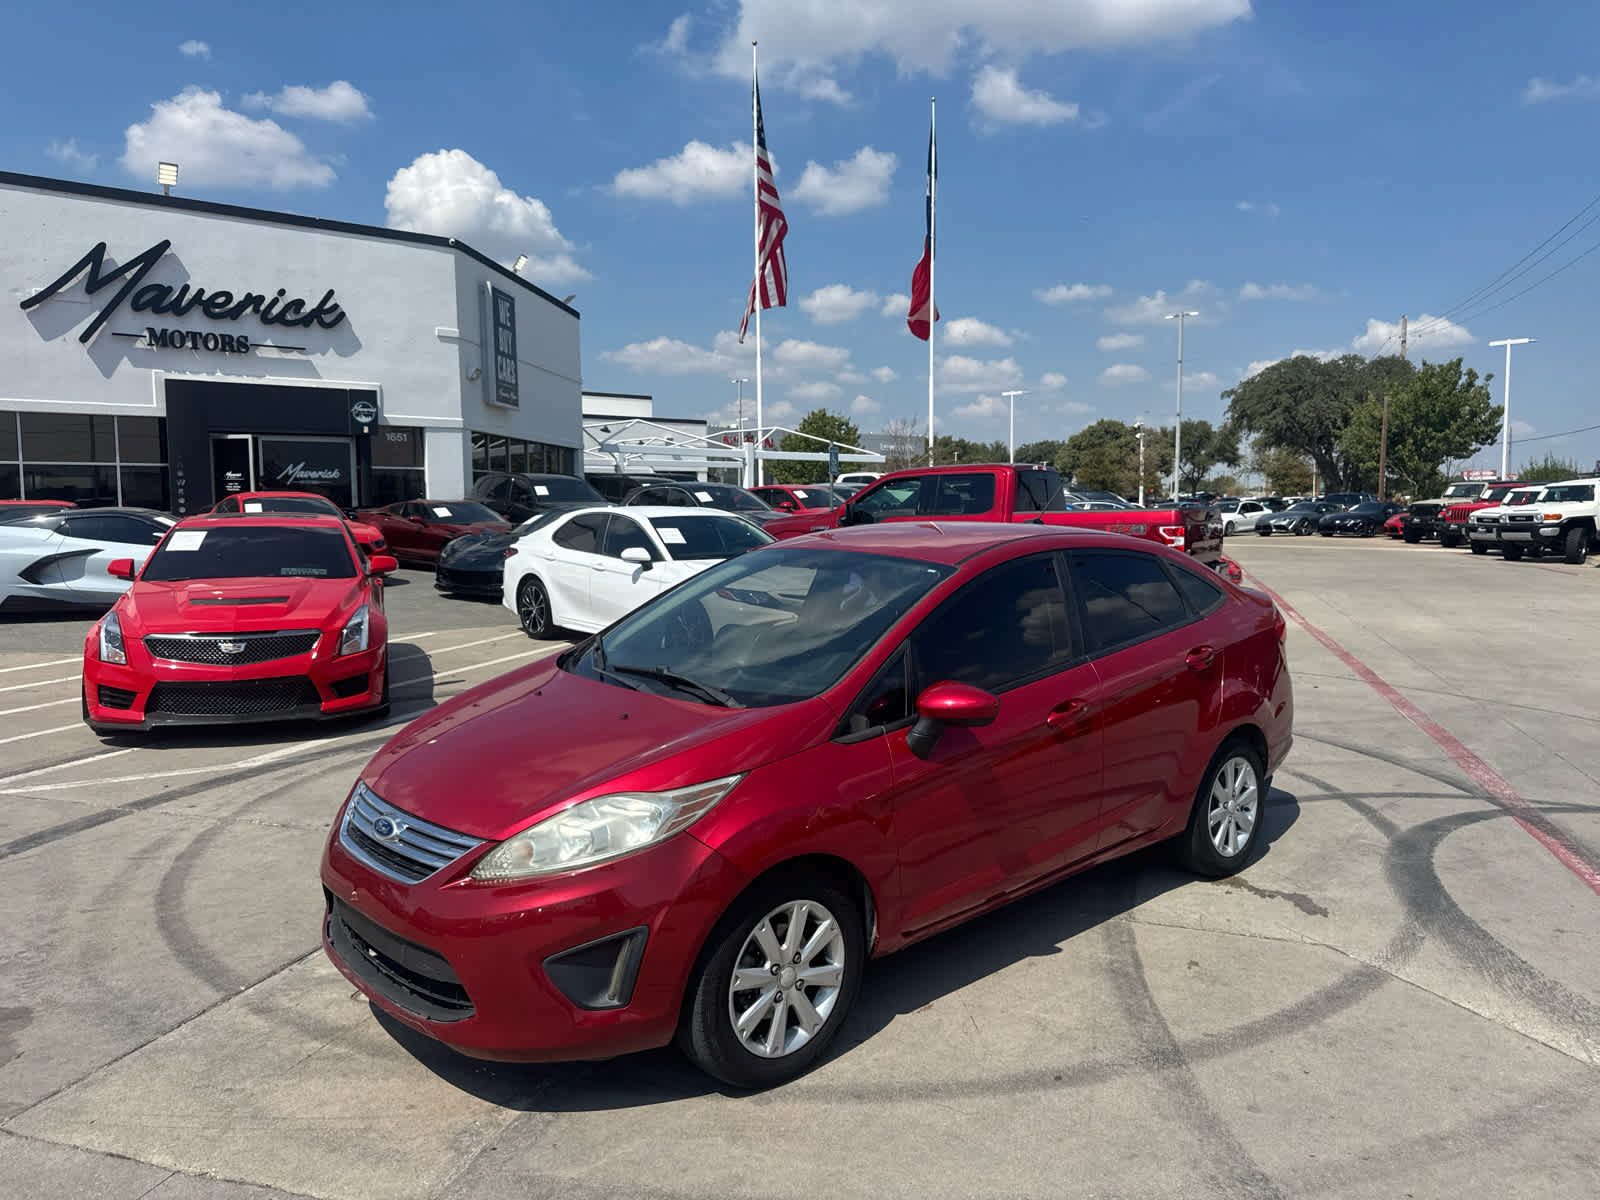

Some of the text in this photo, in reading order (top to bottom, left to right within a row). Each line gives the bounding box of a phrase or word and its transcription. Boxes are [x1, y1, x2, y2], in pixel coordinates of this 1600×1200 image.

[20, 239, 346, 343] Maverick
[498, 297, 511, 328] WE
[146, 327, 250, 354] MOTORS
[498, 355, 517, 385] CARS
[385, 432, 408, 442] 1651
[276, 461, 341, 486] Maverick
